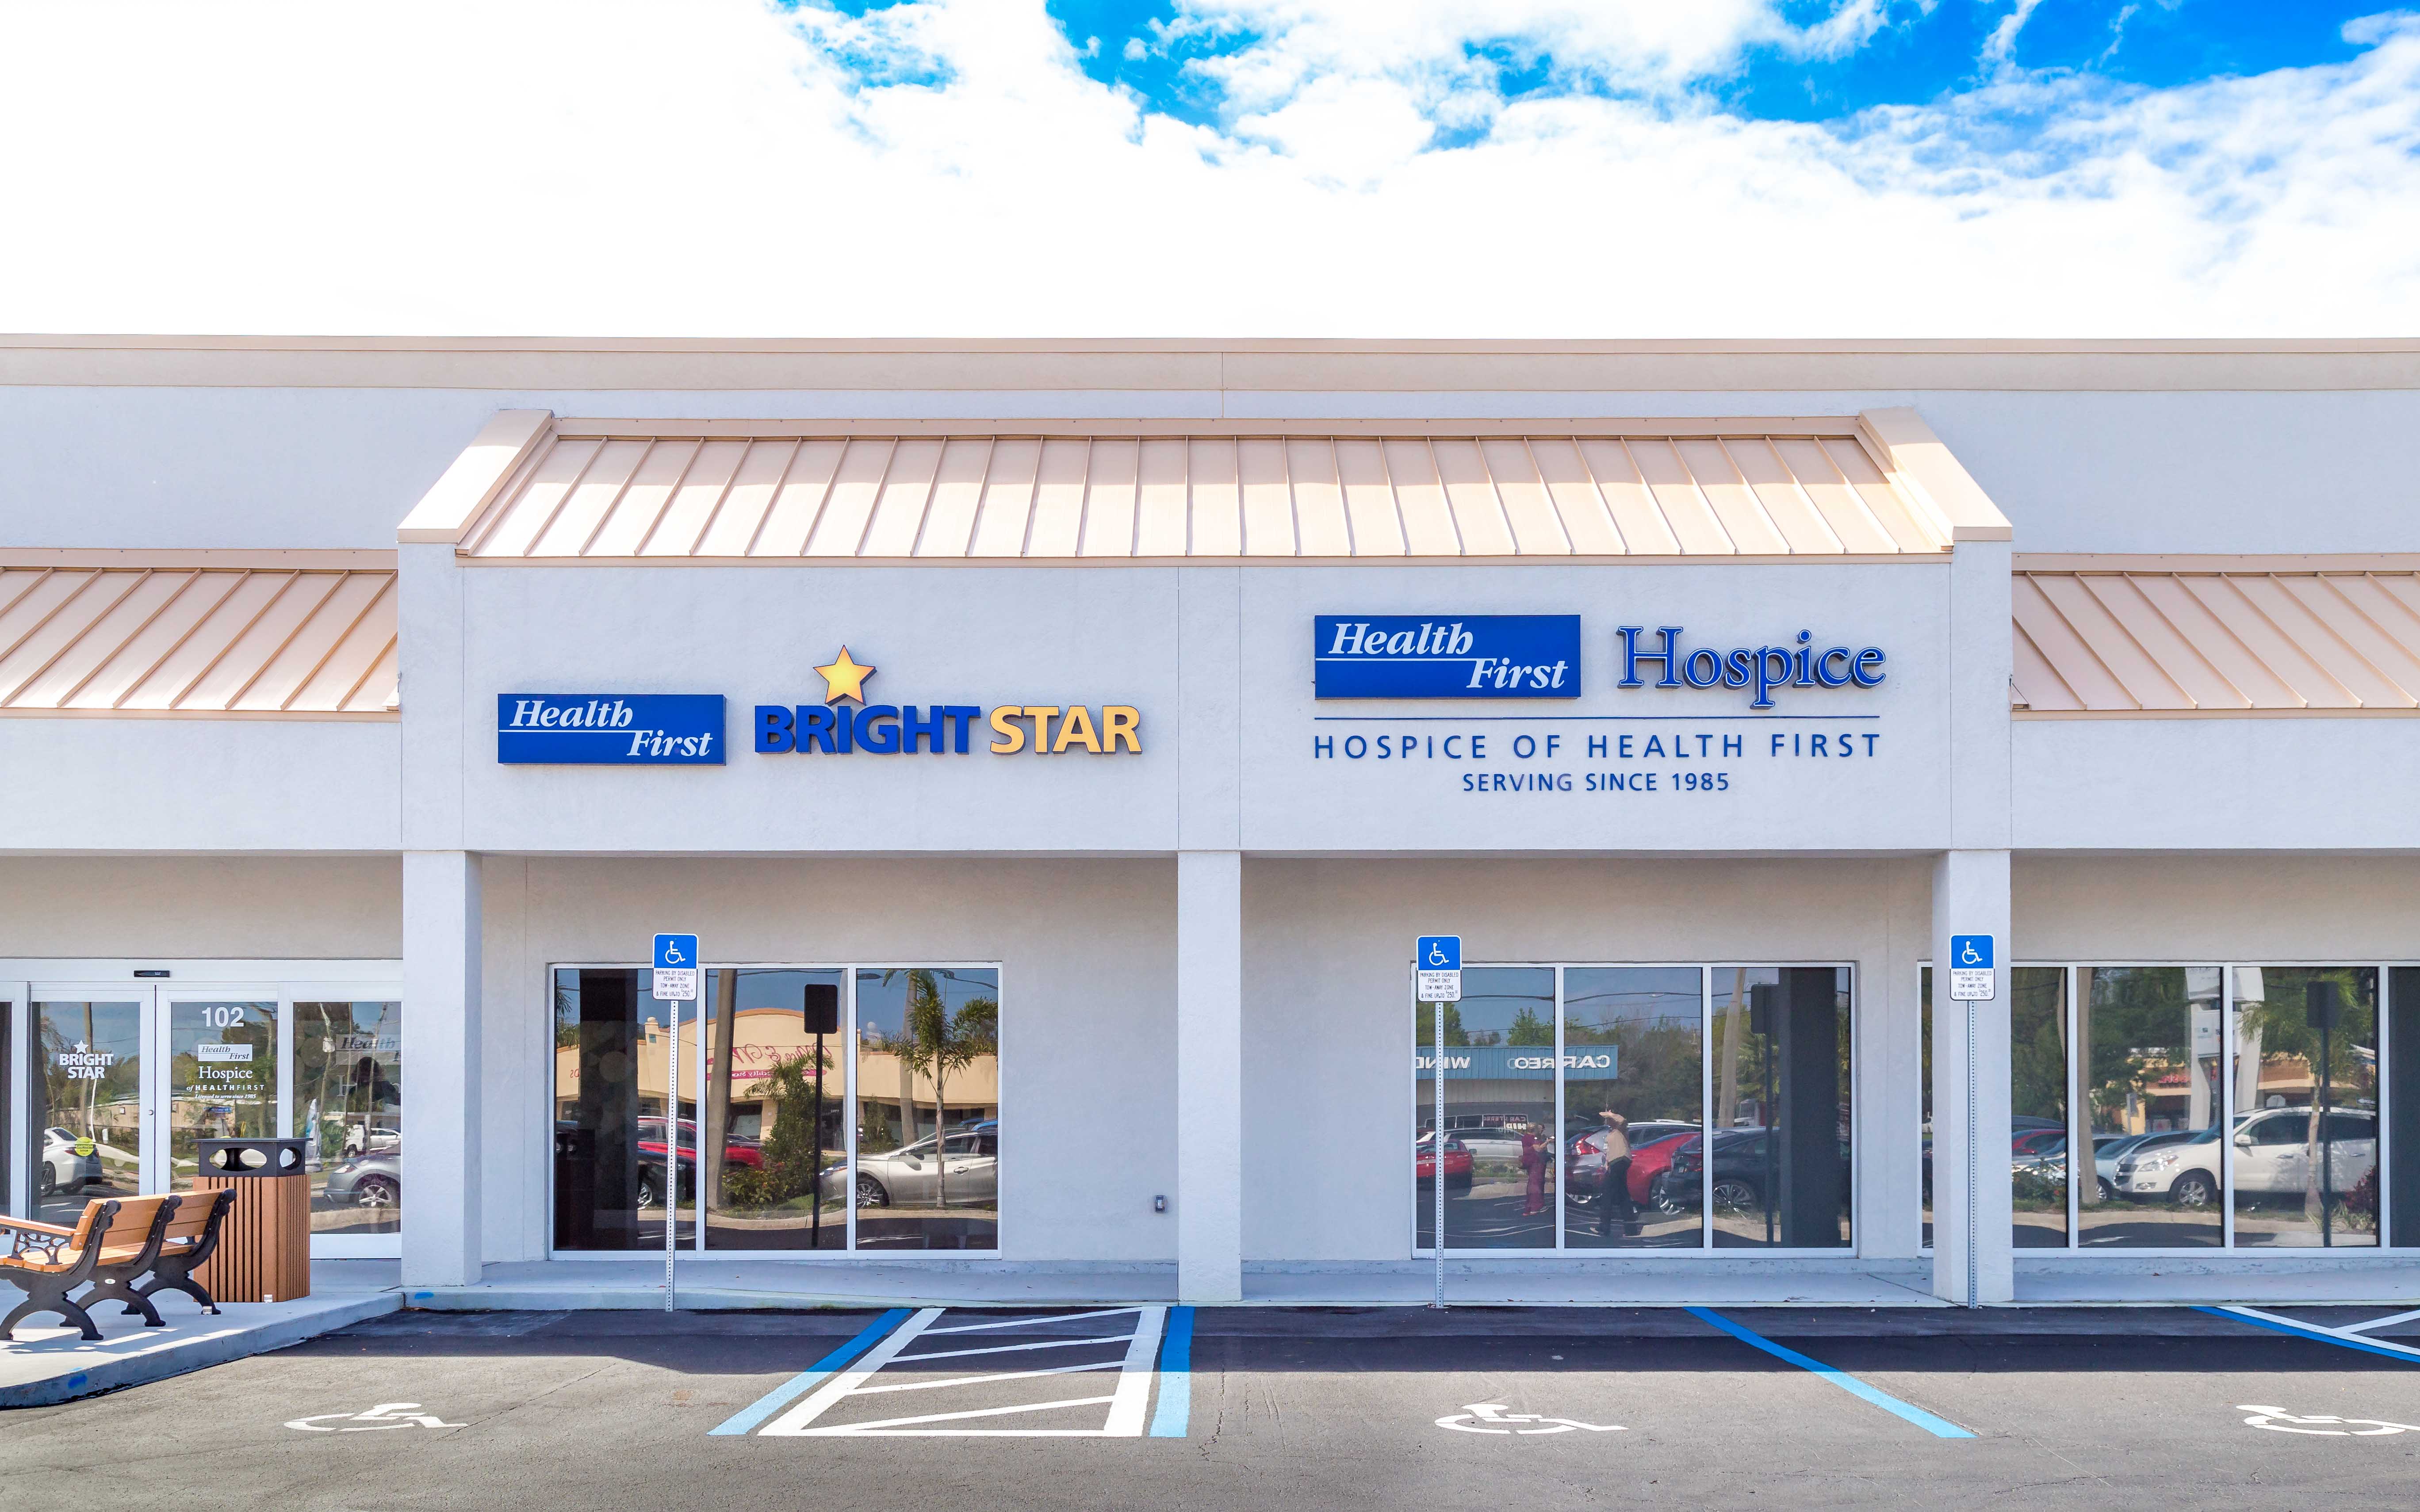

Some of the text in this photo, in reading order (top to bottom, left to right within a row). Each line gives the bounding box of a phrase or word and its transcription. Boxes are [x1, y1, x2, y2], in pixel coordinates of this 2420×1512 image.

[1328, 623, 1474, 655] Health
[1466, 657, 1569, 689] First
[1616, 625, 1887, 710] Hospice
[509, 700, 633, 728] Health
[626, 729, 713, 757] First
[754, 705, 1142, 756] BRIGHT STAR
[1315, 734, 1879, 759] HOSPICE OF HEALTH FIRST
[1463, 773, 1728, 791] SERVING SINCE 1985
[202, 1007, 244, 1027] 102
[341, 1037, 395, 1049] Heath
[59, 1054, 114, 1065] BRIGHT
[68, 1066, 105, 1079] STAR
[199, 1066, 253, 1083] Hospice
